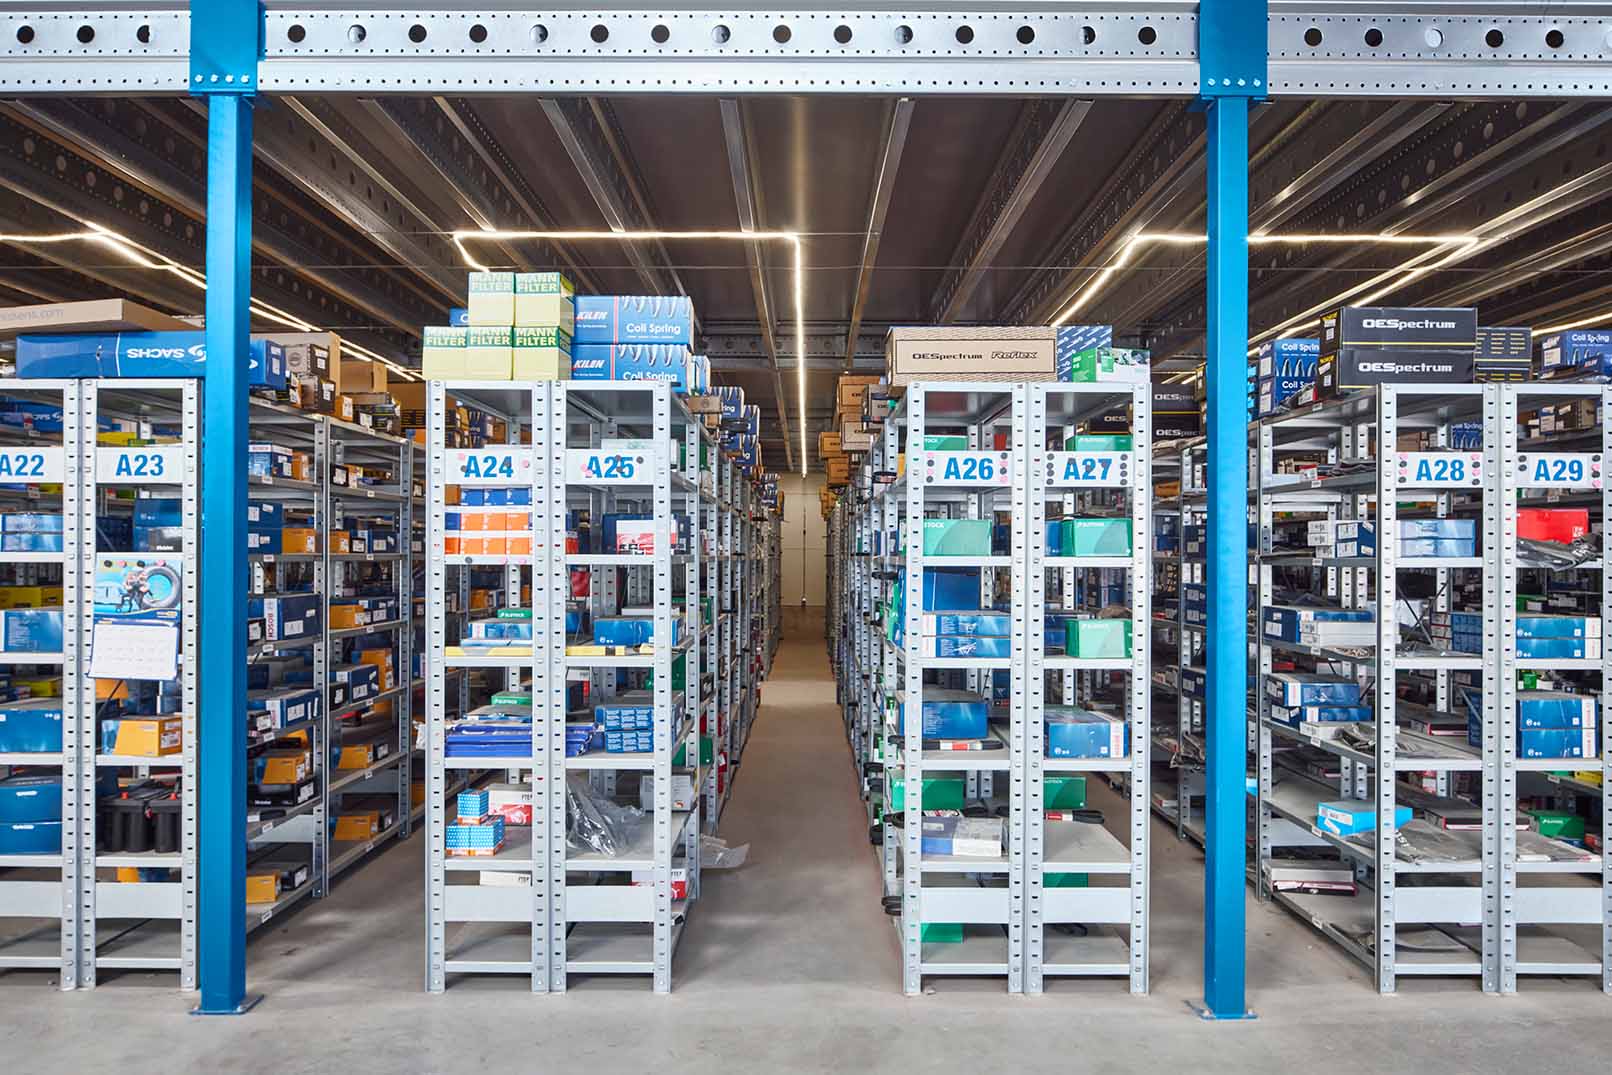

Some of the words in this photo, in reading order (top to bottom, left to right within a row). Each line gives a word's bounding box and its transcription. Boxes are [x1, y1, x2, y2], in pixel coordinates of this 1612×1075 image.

[516, 273, 558, 282] MANN
[471, 282, 513, 292] FILTER
[517, 282, 558, 292] FILTER
[577, 311, 608, 321] KILEN
[626, 322, 646, 333] Coil
[648, 322, 681, 335] Spring
[1362, 318, 1456, 331] OESpectrum
[426, 328, 466, 336] MANN
[470, 328, 511, 336] MANN
[516, 328, 557, 336] MANN
[426, 337, 466, 346] FILTER
[469, 336, 511, 345] FILTER
[516, 336, 557, 346] FILTER
[1571, 333, 1586, 342] Coil
[1587, 334, 1610, 344] Spring
[1281, 342, 1298, 352] Coil
[1299, 343, 1320, 353] Sprin
[127, 348, 185, 359] SACHS
[912, 352, 983, 362] OESpectrum
[991, 350, 1039, 360] Reflex
[573, 359, 606, 369] KILEN
[1358, 362, 1453, 374] OESpectrum
[622, 371, 644, 381] Coil
[645, 372, 678, 382] Spring
[1281, 380, 1298, 389] Coil
[0, 454, 45, 477] A22
[115, 454, 164, 477] A23
[464, 455, 515, 478] A24
[588, 456, 635, 479] A25
[943, 457, 994, 480] A26
[1063, 457, 1113, 480] A27
[1415, 459, 1466, 482] A28
[1533, 459, 1584, 482] A29
